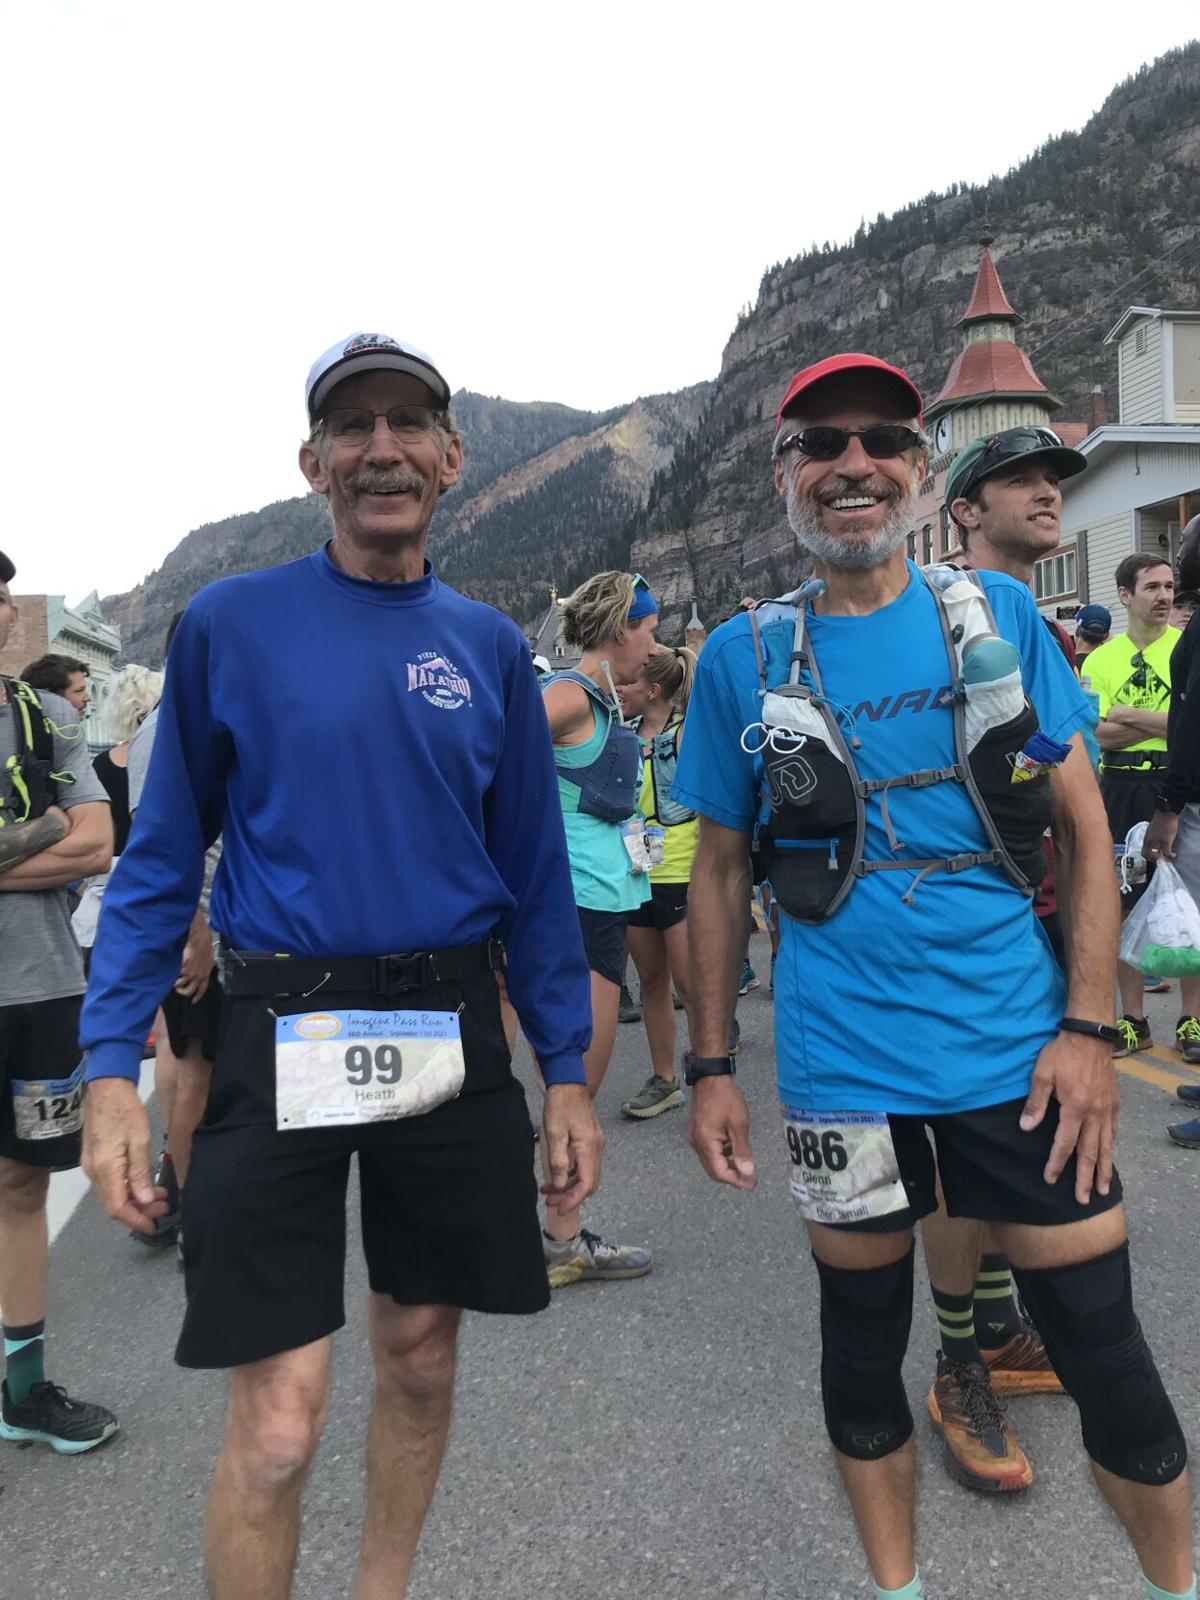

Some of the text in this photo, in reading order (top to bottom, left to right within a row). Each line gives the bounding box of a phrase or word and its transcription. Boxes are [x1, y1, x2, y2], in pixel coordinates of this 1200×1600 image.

[406, 663, 472, 702] MARATHON
[393, 1012, 418, 1026] Pass
[421, 1013, 444, 1026] Run
[345, 1044, 402, 1085] 99
[354, 1089, 397, 1100] Heath
[786, 1126, 848, 1171] 986
[802, 1171, 832, 1185] Glenn
